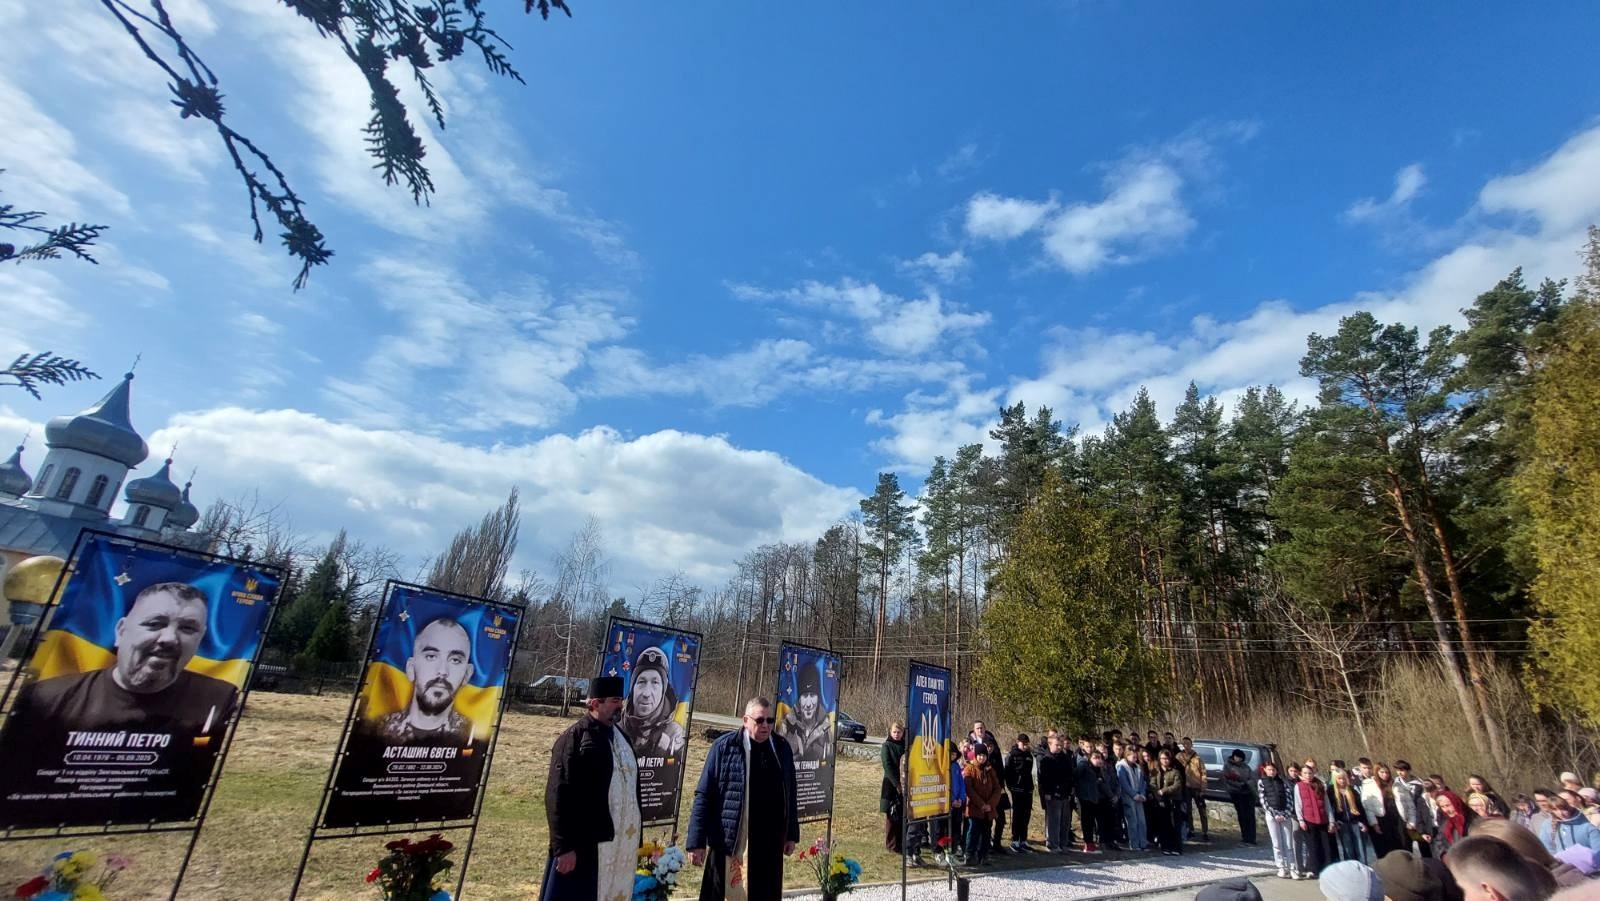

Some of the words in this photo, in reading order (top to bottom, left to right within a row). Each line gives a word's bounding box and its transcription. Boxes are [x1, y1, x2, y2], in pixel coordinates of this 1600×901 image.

[916, 675, 928, 688] АЛЕЯ
[922, 692, 938, 705] ГЕРОЇВ
[66, 731, 127, 747] ТИННИЙ
[126, 733, 171, 748] ПЕТРО
[382, 746, 430, 759] АСТАШИН
[429, 747, 458, 759] ЄВГЕН
[645, 757, 664, 768] ПЕТРО
